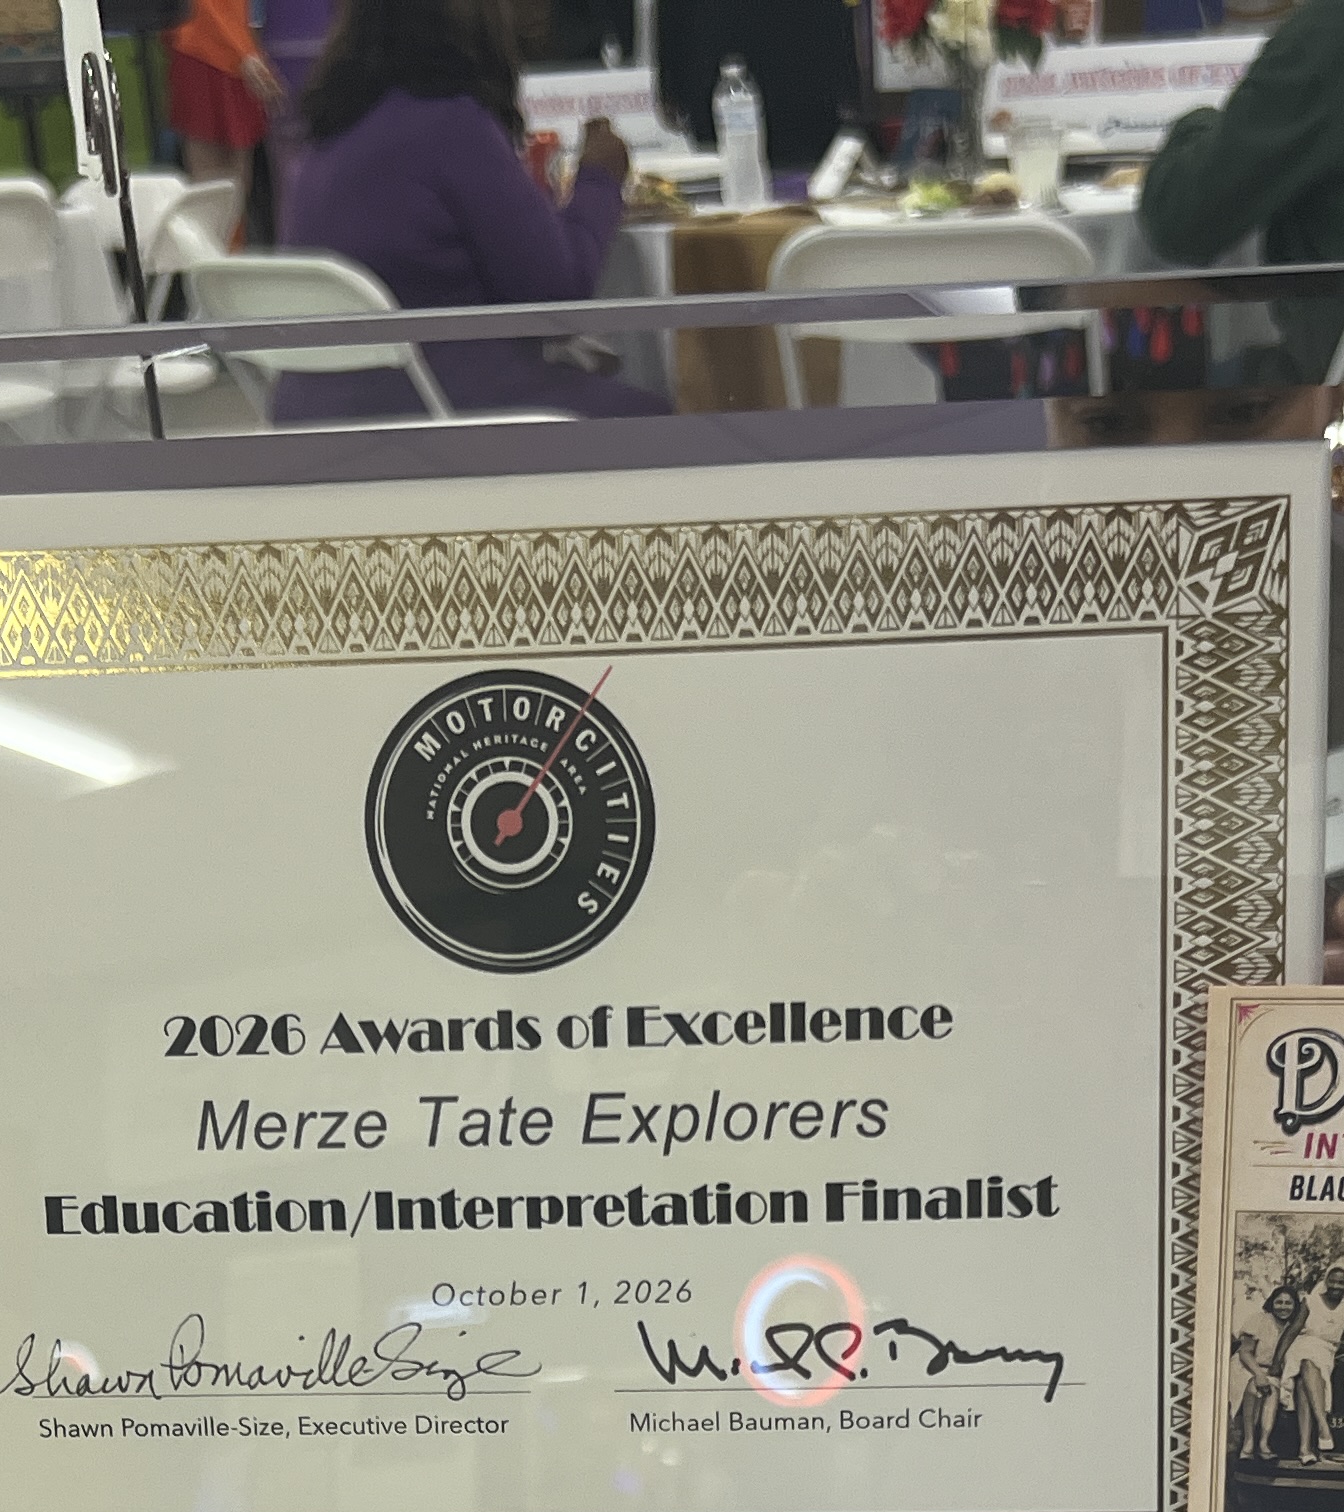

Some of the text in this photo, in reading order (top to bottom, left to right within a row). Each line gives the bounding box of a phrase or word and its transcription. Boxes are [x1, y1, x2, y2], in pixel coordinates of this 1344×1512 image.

[414, 696, 630, 915] MOTORCITIES
[426, 733, 588, 821] NATIONAL HERITAGE AREA
[163, 1003, 952, 1056] 2026 Awards of Excellence
[198, 1091, 888, 1156] Merze Tate Explorers
[45, 1175, 1060, 1237] Education/Interpretation Finalist
[432, 1279, 692, 1309] October 1, 2026
[39, 1415, 510, 1440] Shawn Pomaville-Size, Executive Director
[630, 1408, 982, 1433] Michael Bauman, Board Chair
